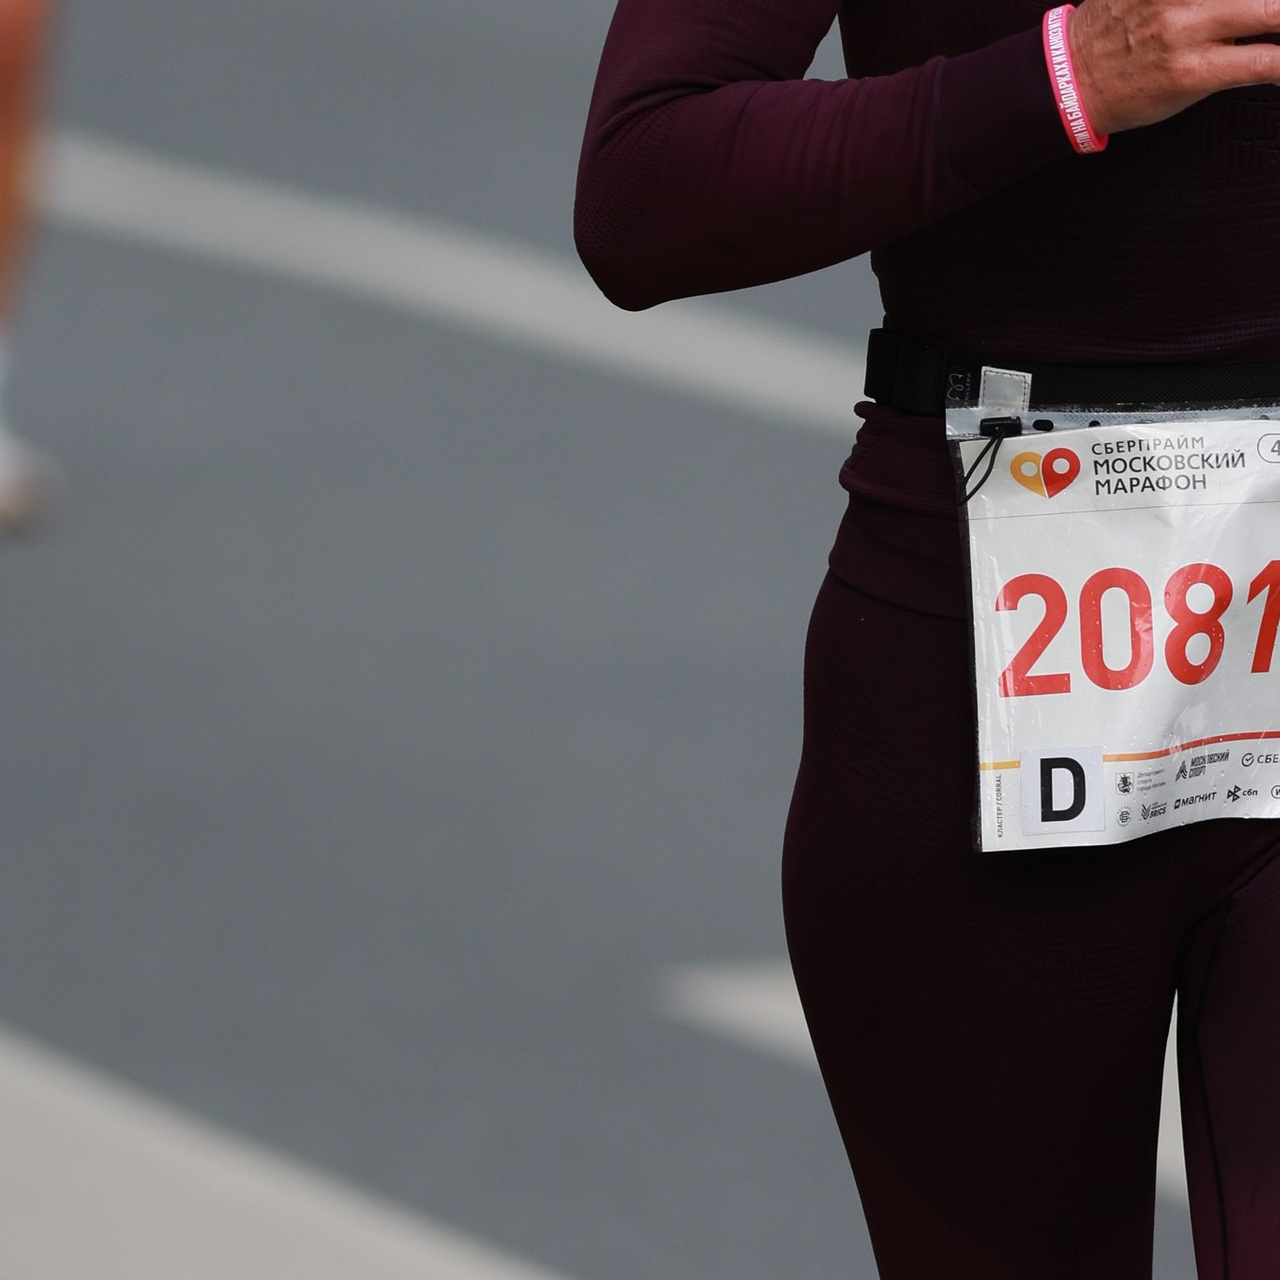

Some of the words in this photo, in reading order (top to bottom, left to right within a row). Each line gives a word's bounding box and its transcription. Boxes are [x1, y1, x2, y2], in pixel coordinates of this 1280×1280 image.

[1048, 28, 1065, 56] КАНОЭ
[1052, 54, 1067, 63] И
[1053, 61, 1082, 120] БАЙДАРКАХ
[1070, 118, 1087, 133] НА
[1092, 434, 1204, 455] СБЕРПРАЙМ
[1093, 449, 1246, 475] МОСКОВСКИЙ
[1095, 474, 1207, 495] МАРАФОН
[1189, 765, 1206, 778] СПОРТ
[1040, 757, 1086, 822] D
[1242, 788, 1258, 796] сбп
